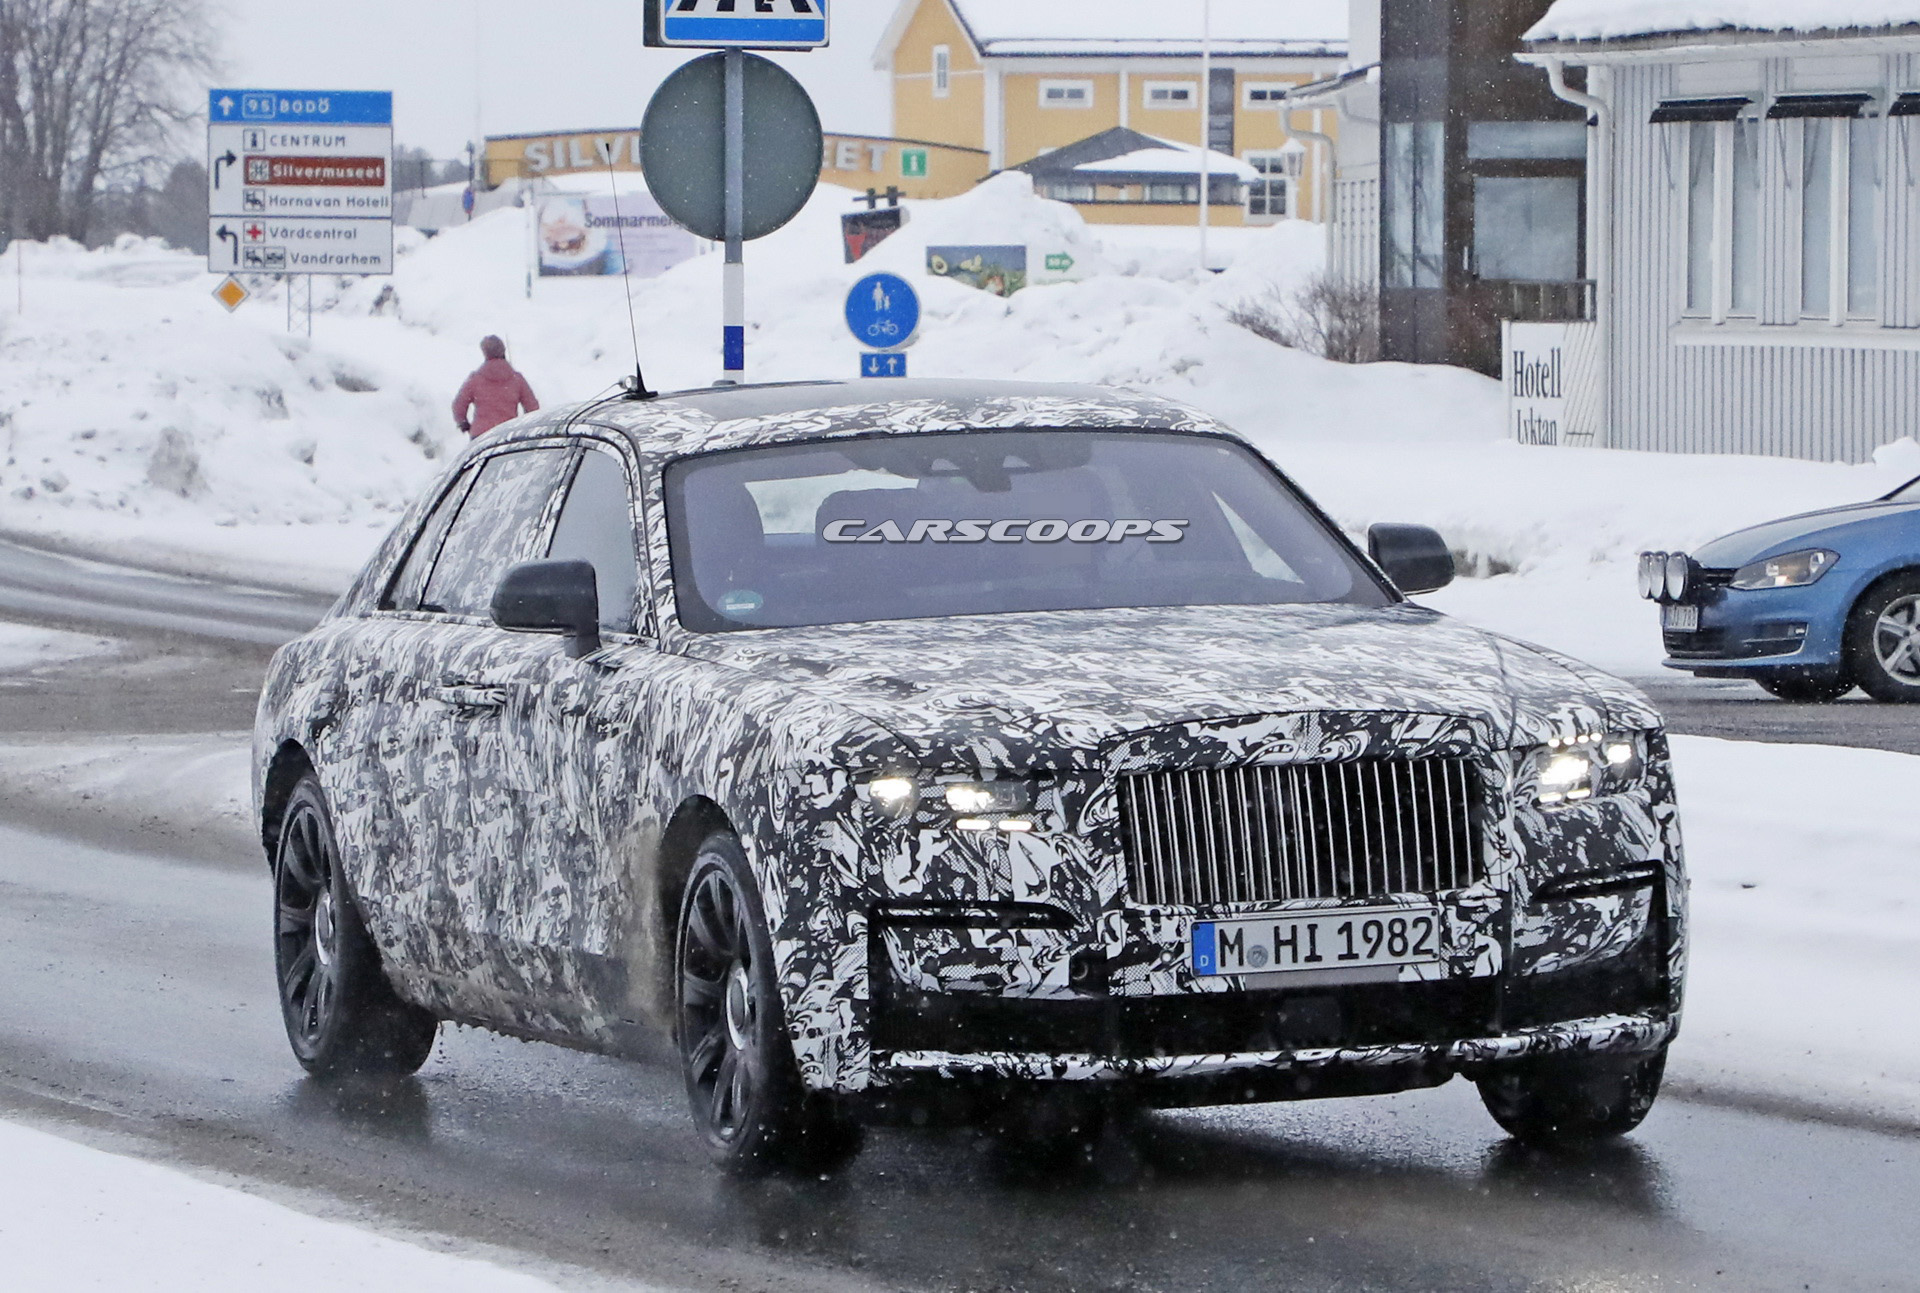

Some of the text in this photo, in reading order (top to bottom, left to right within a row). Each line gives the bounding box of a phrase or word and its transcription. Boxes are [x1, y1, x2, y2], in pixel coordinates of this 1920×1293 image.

[270, 135, 346, 147] CENTRUM
[273, 163, 382, 179] Silvermuseet
[268, 196, 389, 208] Hornavan Hotell
[291, 252, 381, 265] Vandrarhem
[1513, 347, 1561, 398] Hotell
[1218, 916, 1433, 967] M HI 1982
[1200, 954, 1208, 967] D
